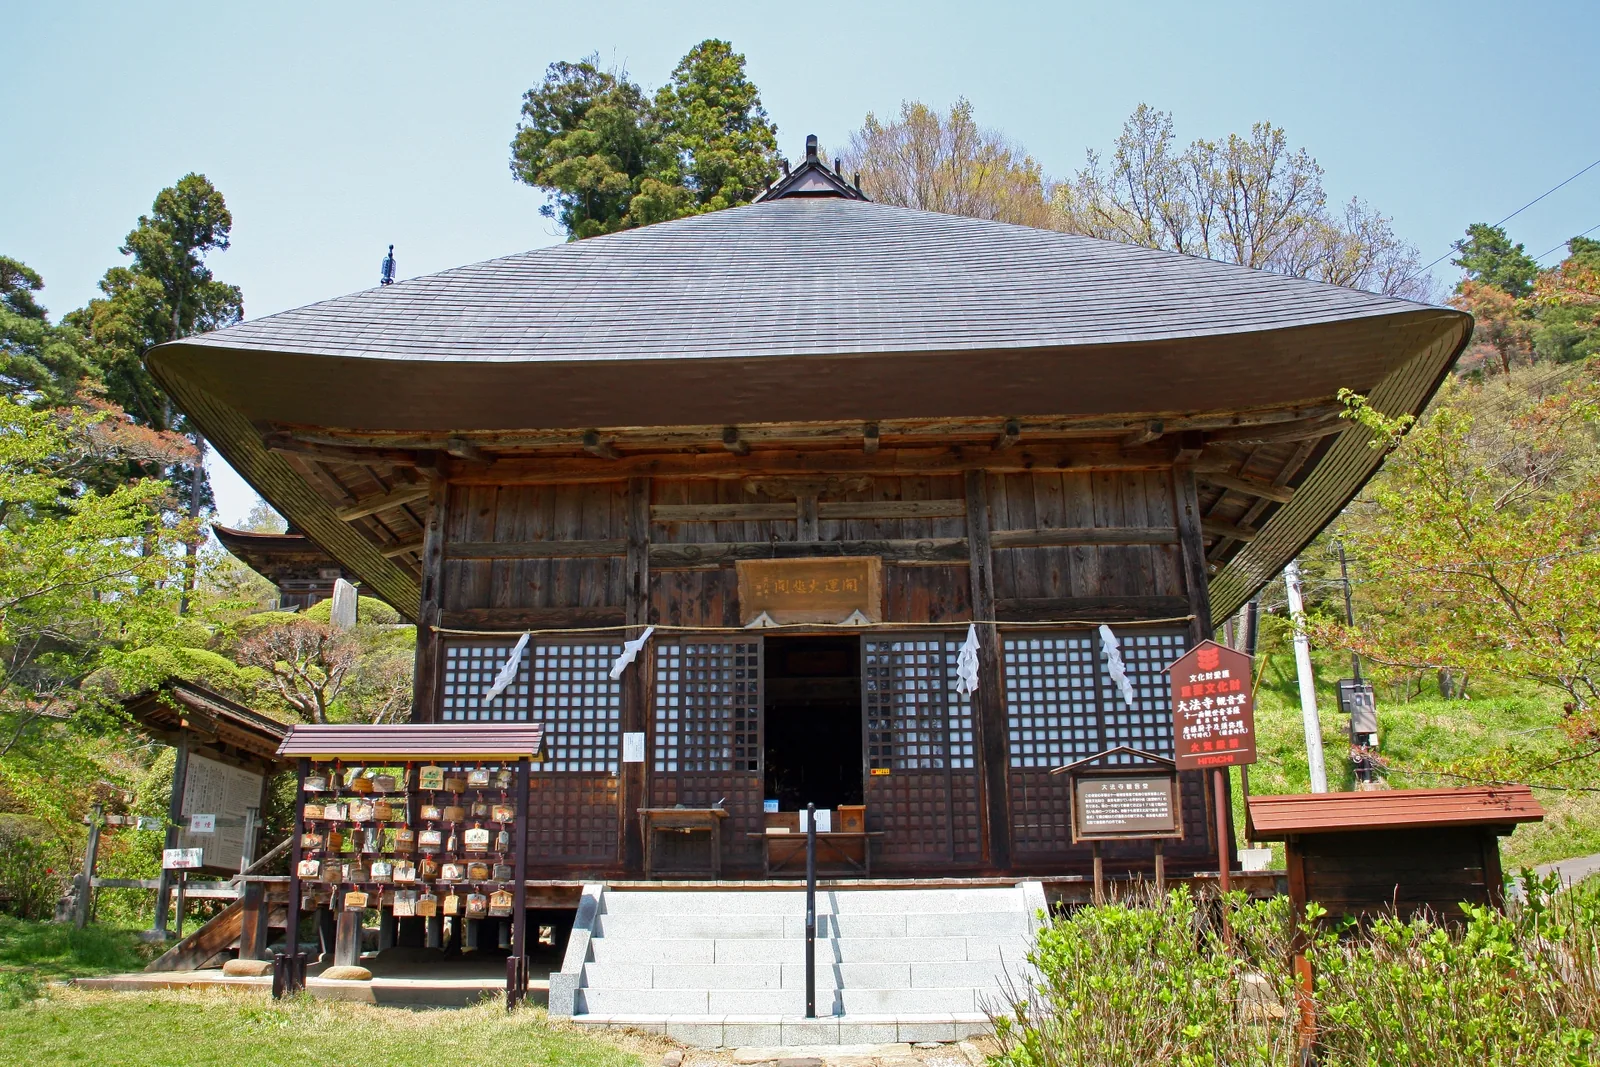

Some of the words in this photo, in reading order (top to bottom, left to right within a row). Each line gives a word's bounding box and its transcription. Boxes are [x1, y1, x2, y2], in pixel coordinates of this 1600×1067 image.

[1189, 669, 1230, 683] 文化財愛護
[1181, 679, 1241, 698] 重要文化財
[1177, 696, 1214, 713] 大法寺
[1216, 693, 1247, 707] 観音堂
[1190, 738, 1240, 753] 火気厳禁
[1197, 755, 1235, 765] HITACHI
[1101, 782, 1149, 791] 大法寺観音堂
